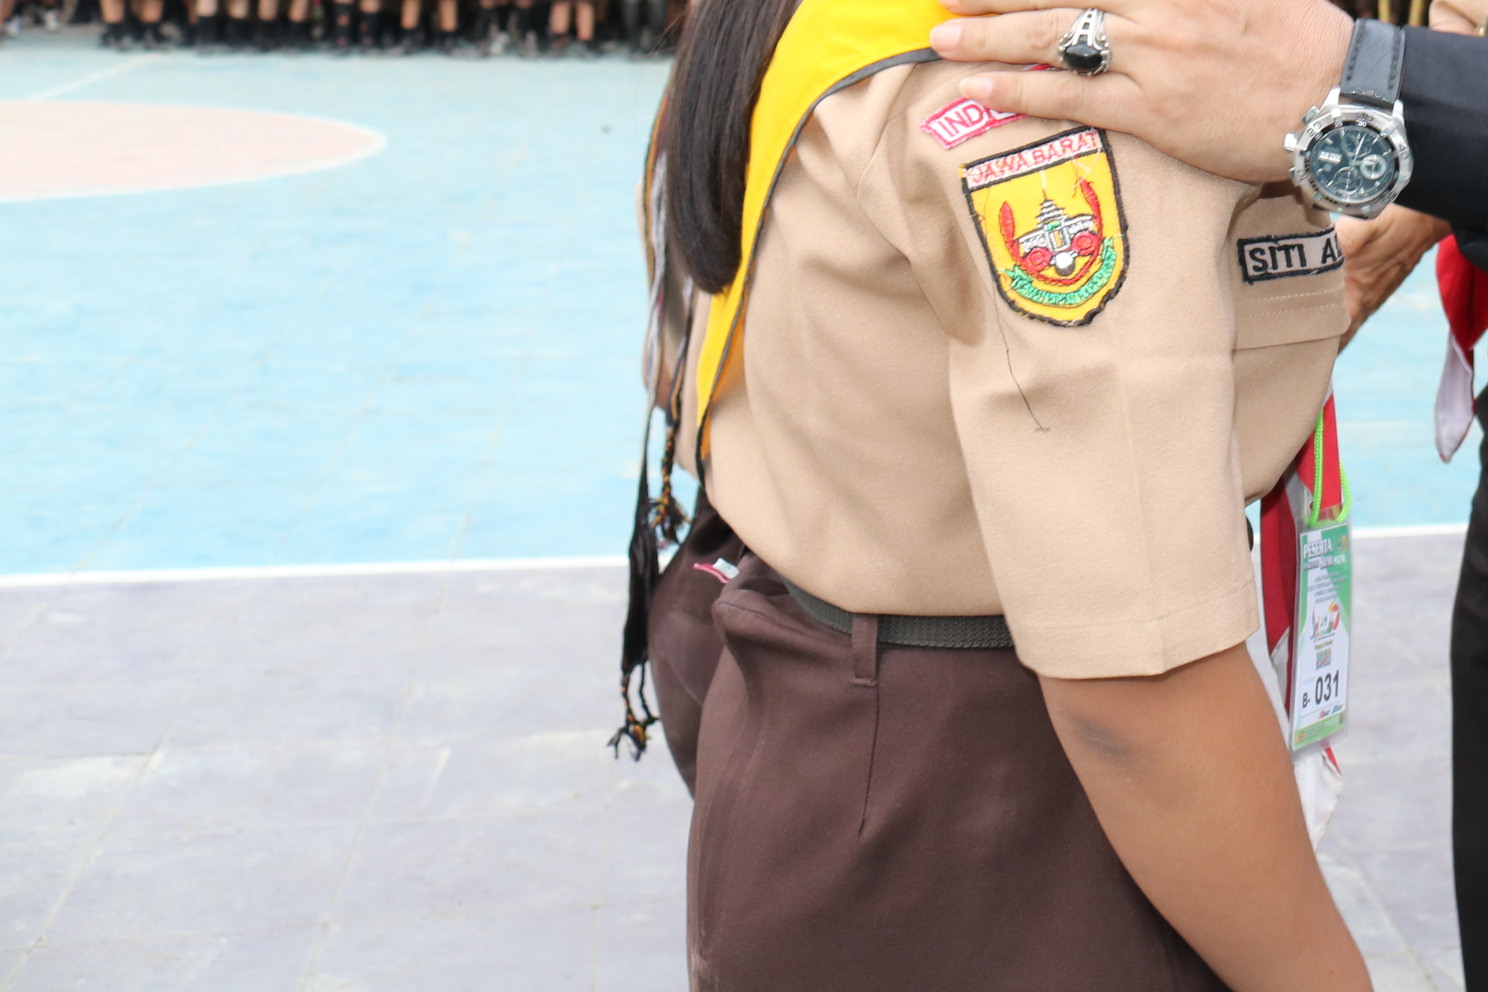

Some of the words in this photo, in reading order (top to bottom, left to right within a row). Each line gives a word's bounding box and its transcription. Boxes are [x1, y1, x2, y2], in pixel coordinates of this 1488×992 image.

[973, 151, 1029, 183] JAWA
[1031, 131, 1098, 167] BARAT
[1249, 244, 1307, 272] SITI
[1315, 669, 1340, 705] 031
